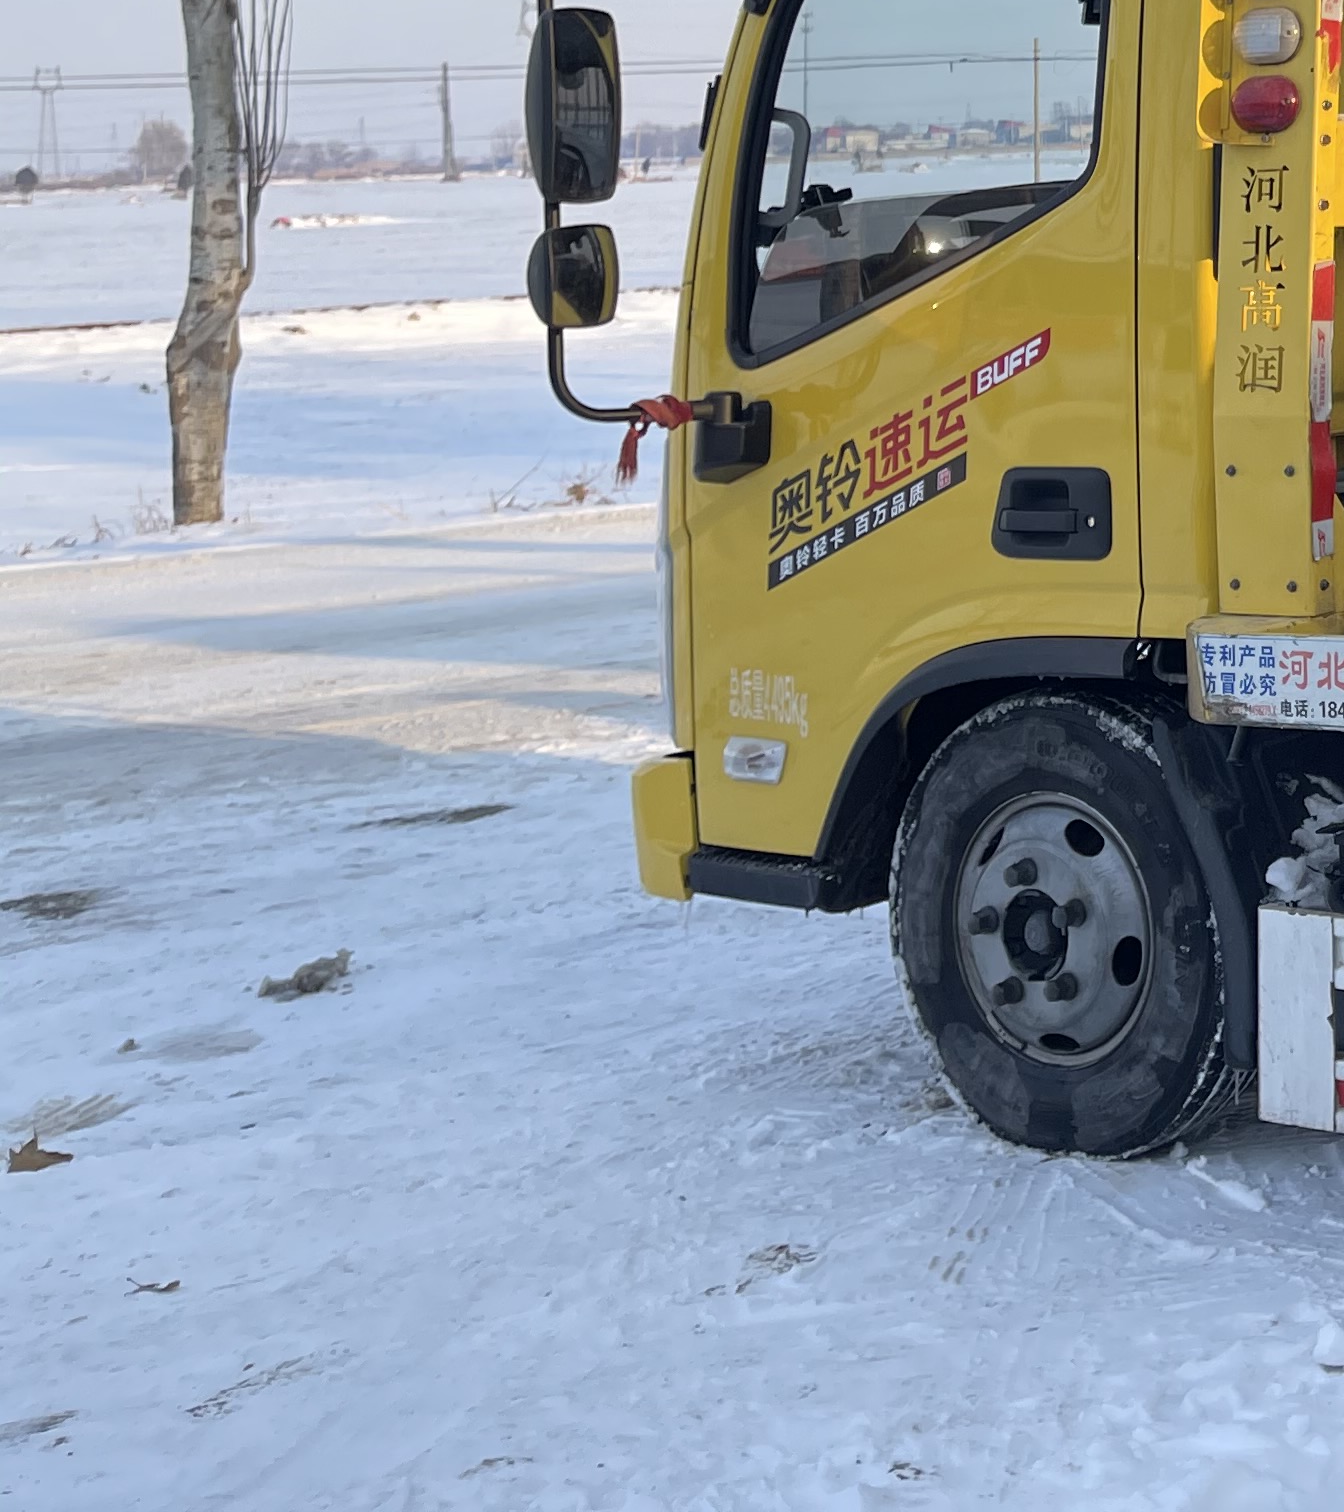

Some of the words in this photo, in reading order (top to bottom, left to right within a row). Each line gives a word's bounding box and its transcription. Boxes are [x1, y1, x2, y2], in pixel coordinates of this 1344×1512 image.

[1235, 165, 1290, 393] 河北高润
[976, 337, 1042, 394] BUFF
[769, 375, 968, 555] 奥铃速运
[1201, 643, 1276, 668] 专利产品
